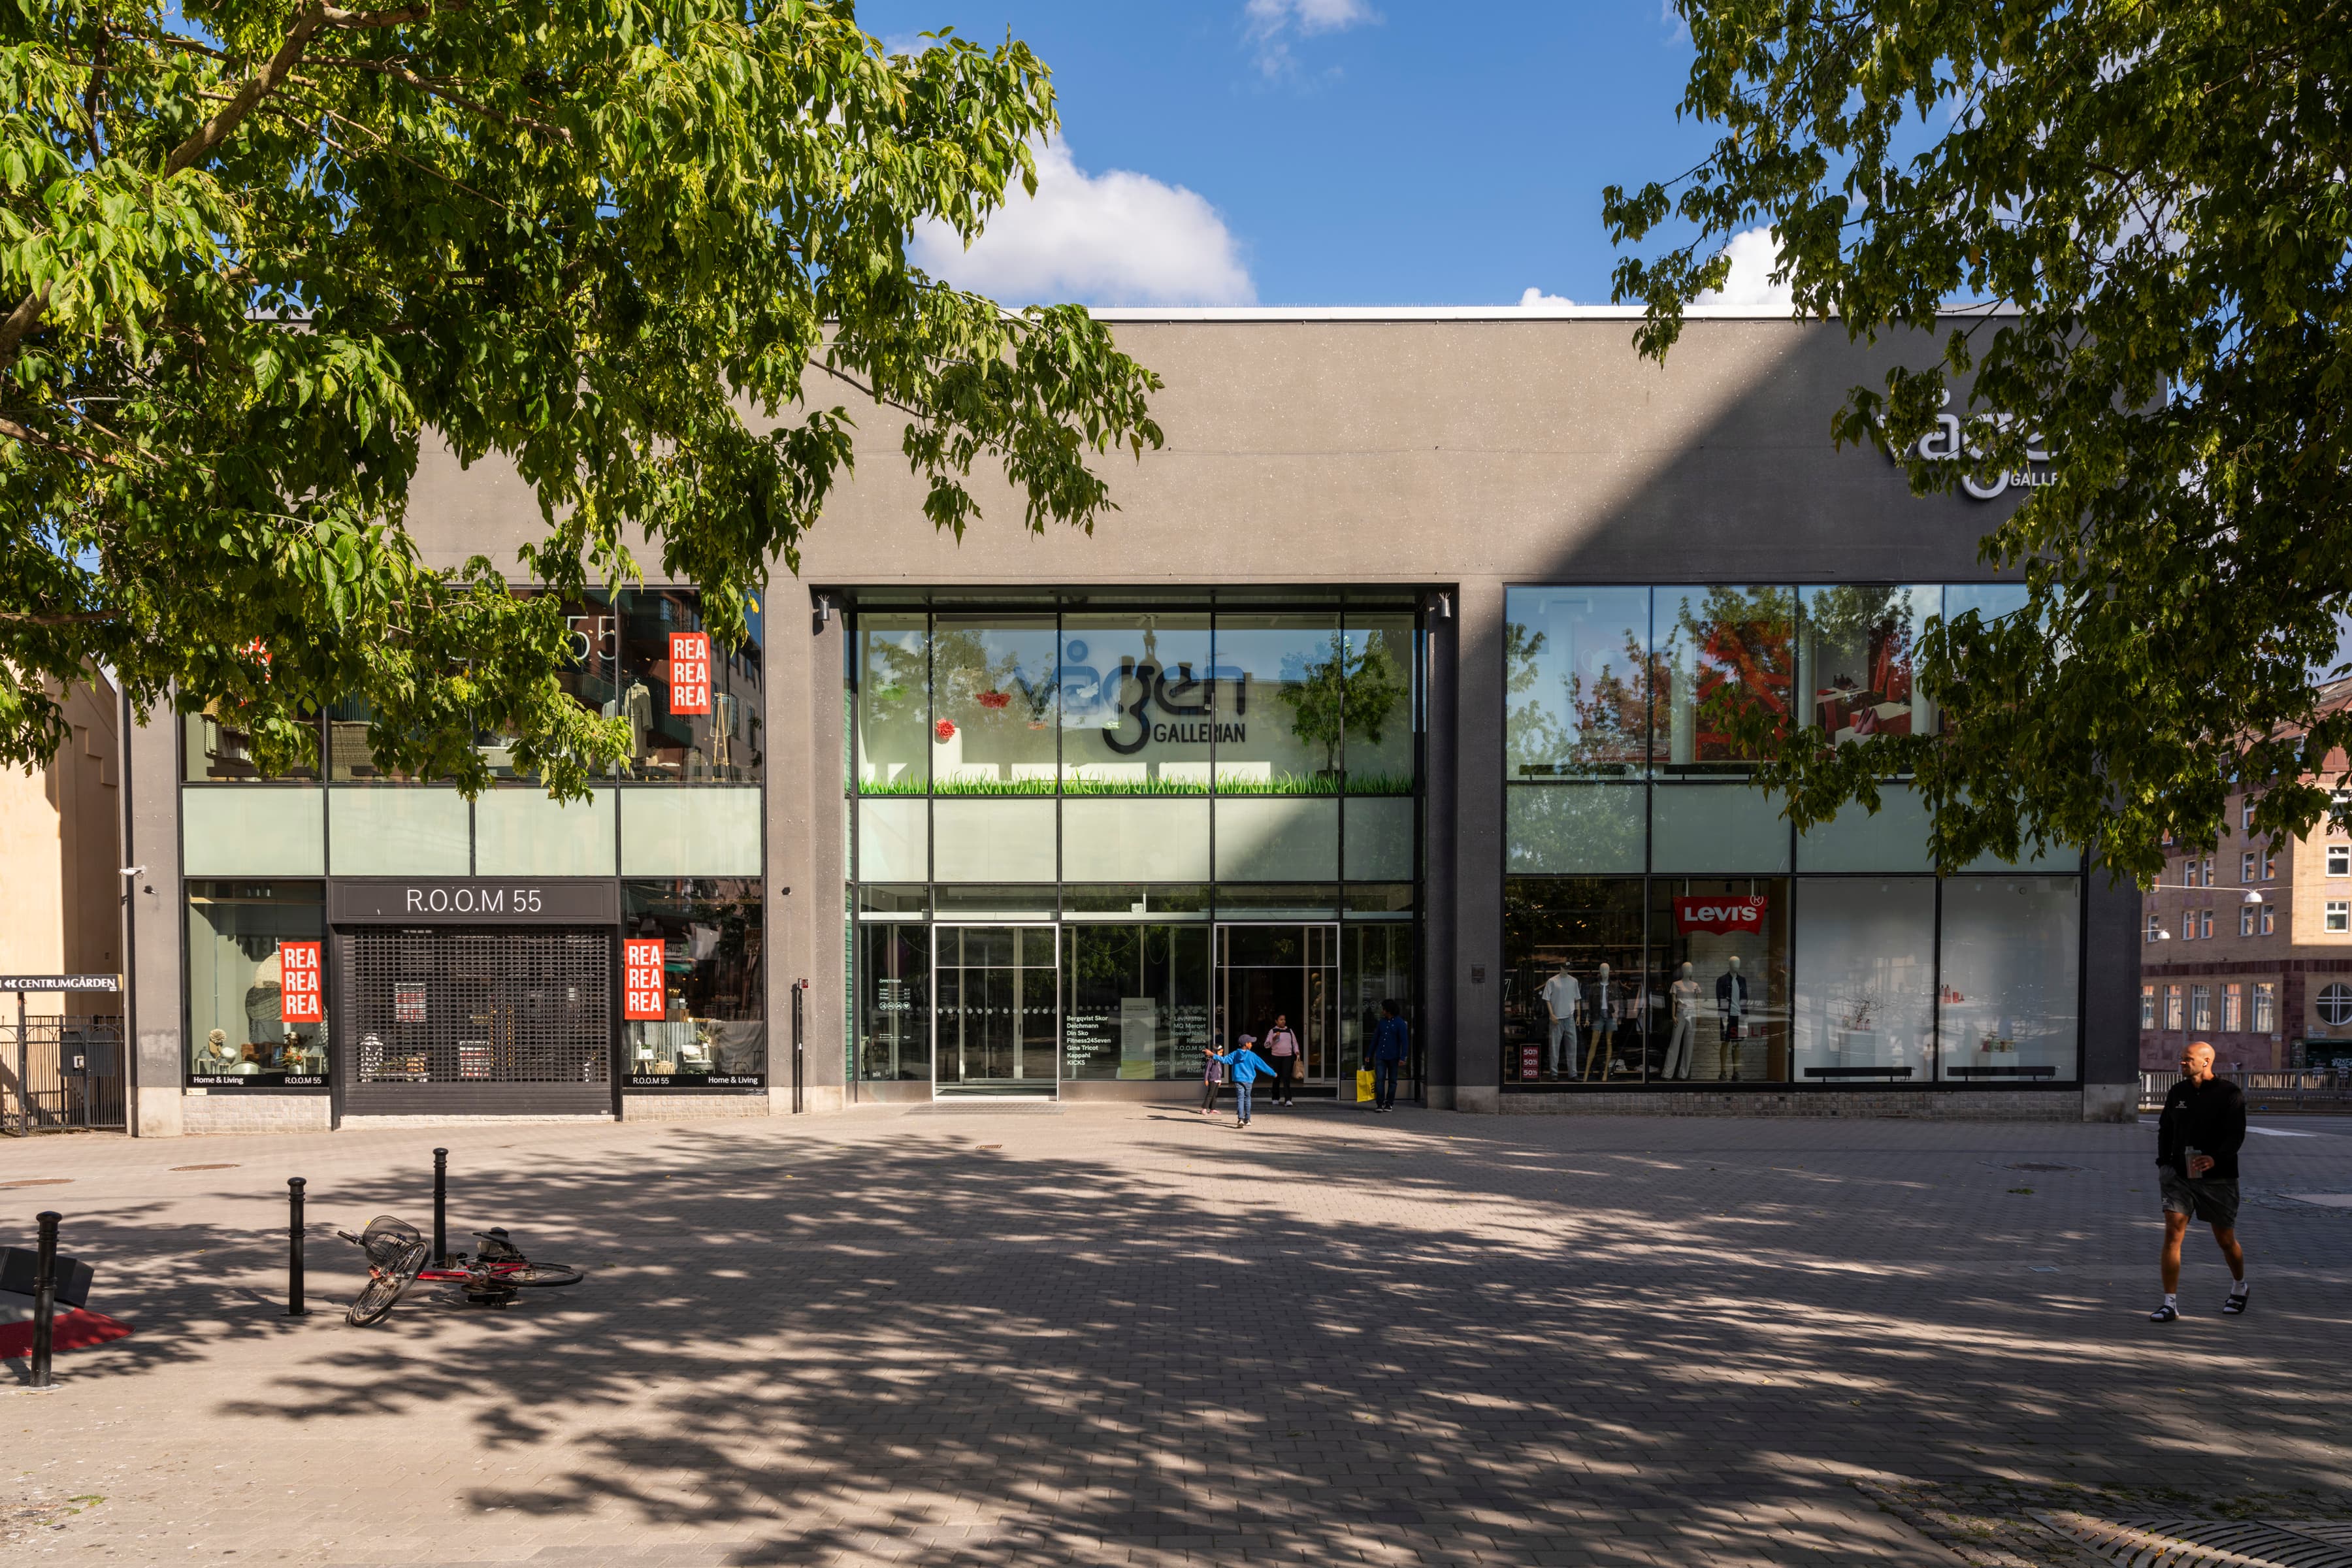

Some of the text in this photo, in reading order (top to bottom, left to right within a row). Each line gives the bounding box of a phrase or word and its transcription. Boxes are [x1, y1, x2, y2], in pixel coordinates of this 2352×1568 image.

[674, 639, 706, 659] REA
[674, 662, 707, 683] REA
[674, 685, 707, 706] REA
[1154, 723, 1246, 743] GALLERIAN
[407, 889, 542, 912] R.O.O.M 55
[284, 948, 318, 968] REA
[629, 945, 661, 966] REA
[18, 976, 116, 988] CENTRUMGÅRDEN
[285, 971, 319, 991] REA
[629, 968, 661, 988] REA
[286, 994, 319, 1015] REA
[629, 991, 661, 1012] REA
[223, 1076, 244, 1085] Living
[738, 1076, 758, 1085] Living
